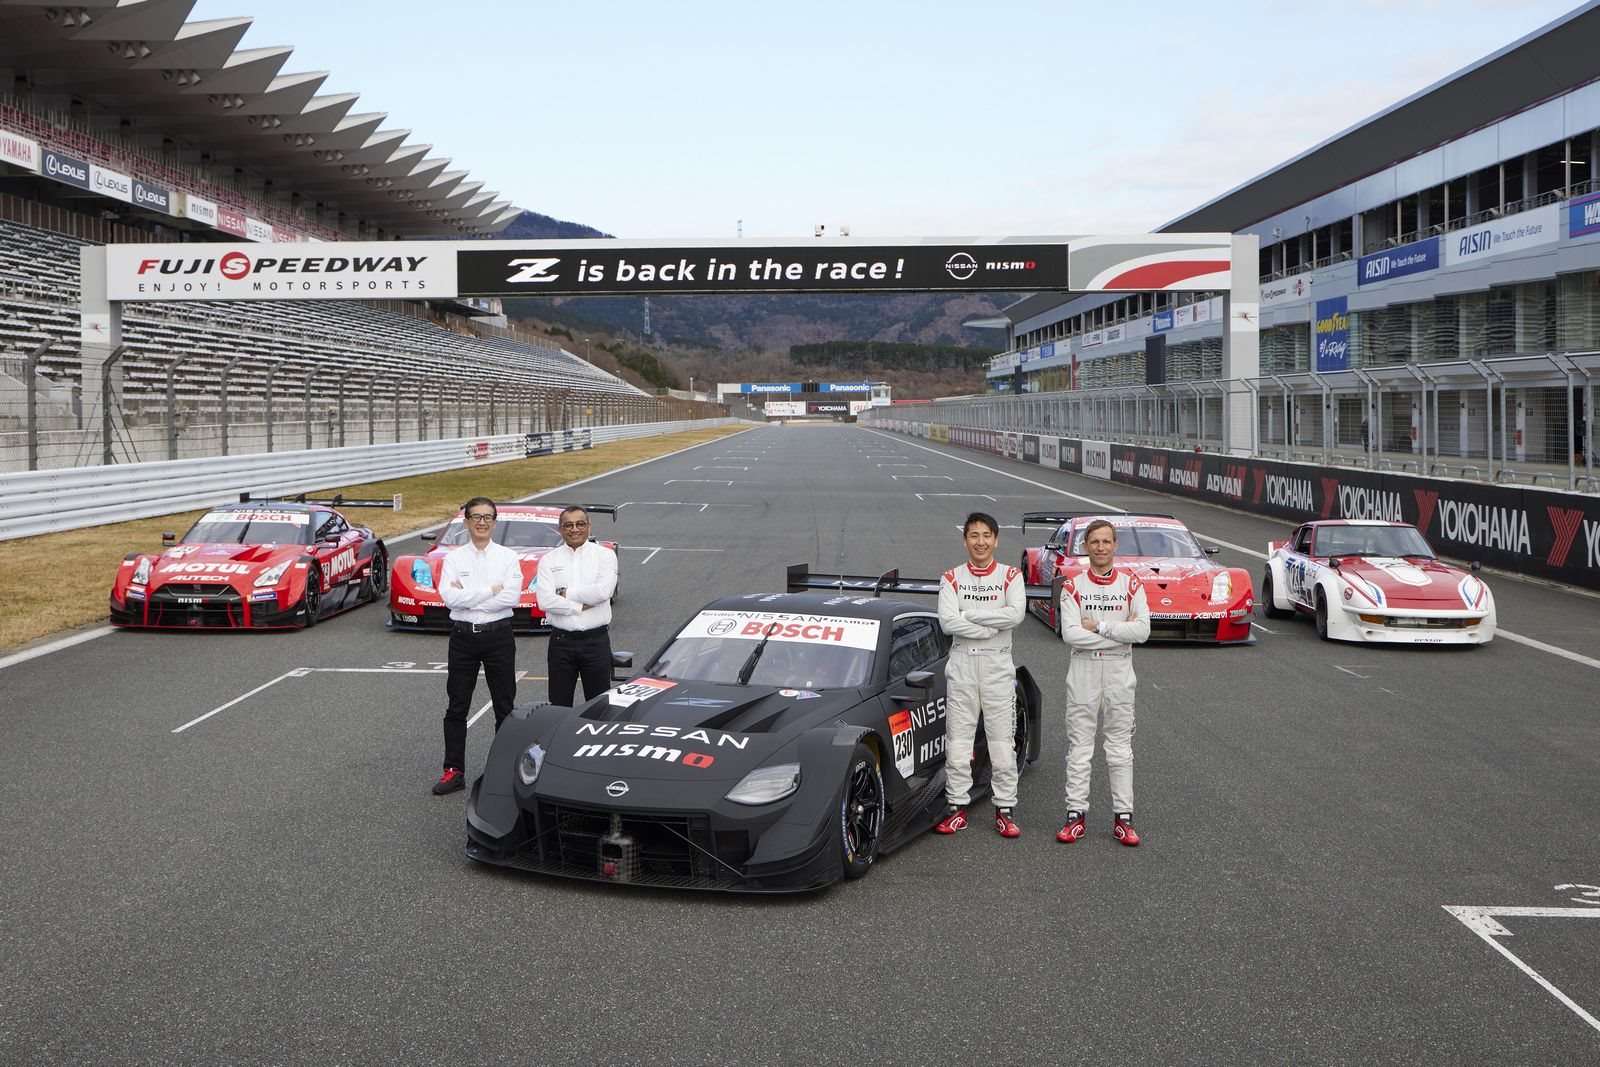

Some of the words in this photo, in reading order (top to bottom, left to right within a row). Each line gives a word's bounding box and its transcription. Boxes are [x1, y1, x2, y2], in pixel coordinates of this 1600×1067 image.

[3, 137, 32, 164] YAMAHA
[57, 162, 86, 181] LEXUS
[103, 177, 128, 194] LEXUS
[144, 191, 167, 206] LEXUS
[218, 213, 246, 233] NISSAN
[1459, 230, 1492, 256] AISIN
[1517, 228, 1525, 238] the
[1526, 224, 1542, 236] Future
[138, 259, 214, 274] FUJI
[221, 253, 427, 277] SPEEDWAY
[577, 259, 604, 282] is
[616, 259, 697, 282] back
[706, 258, 737, 281] in
[749, 258, 803, 281] the
[1366, 256, 1390, 278] AISIN
[139, 282, 222, 292] ENJOY!
[253, 280, 427, 291] MOTORSPORTS
[751, 384, 791, 392] Panasonic
[1112, 458, 1134, 476] ADVAN
[1138, 463, 1163, 482] ADVAN
[1169, 467, 1198, 489] ADVAN
[1206, 473, 1242, 497] ADVAN
[1265, 474, 1314, 512] YOKOHAMA
[1338, 484, 1403, 523] YOKOHAMA
[236, 513, 292, 522] BOSCH
[1438, 499, 1532, 555] YOKOHAMA
[159, 563, 251, 575] MOTUL
[330, 547, 356, 577] MOTUL
[398, 596, 415, 606] MOTUL
[1081, 594, 1127, 602] NISSAN
[739, 612, 824, 623] NISSAN
[740, 621, 845, 642] BOSCH
[910, 697, 947, 731] NISS
[575, 723, 750, 750] NISSAN
[895, 729, 913, 762] 230
